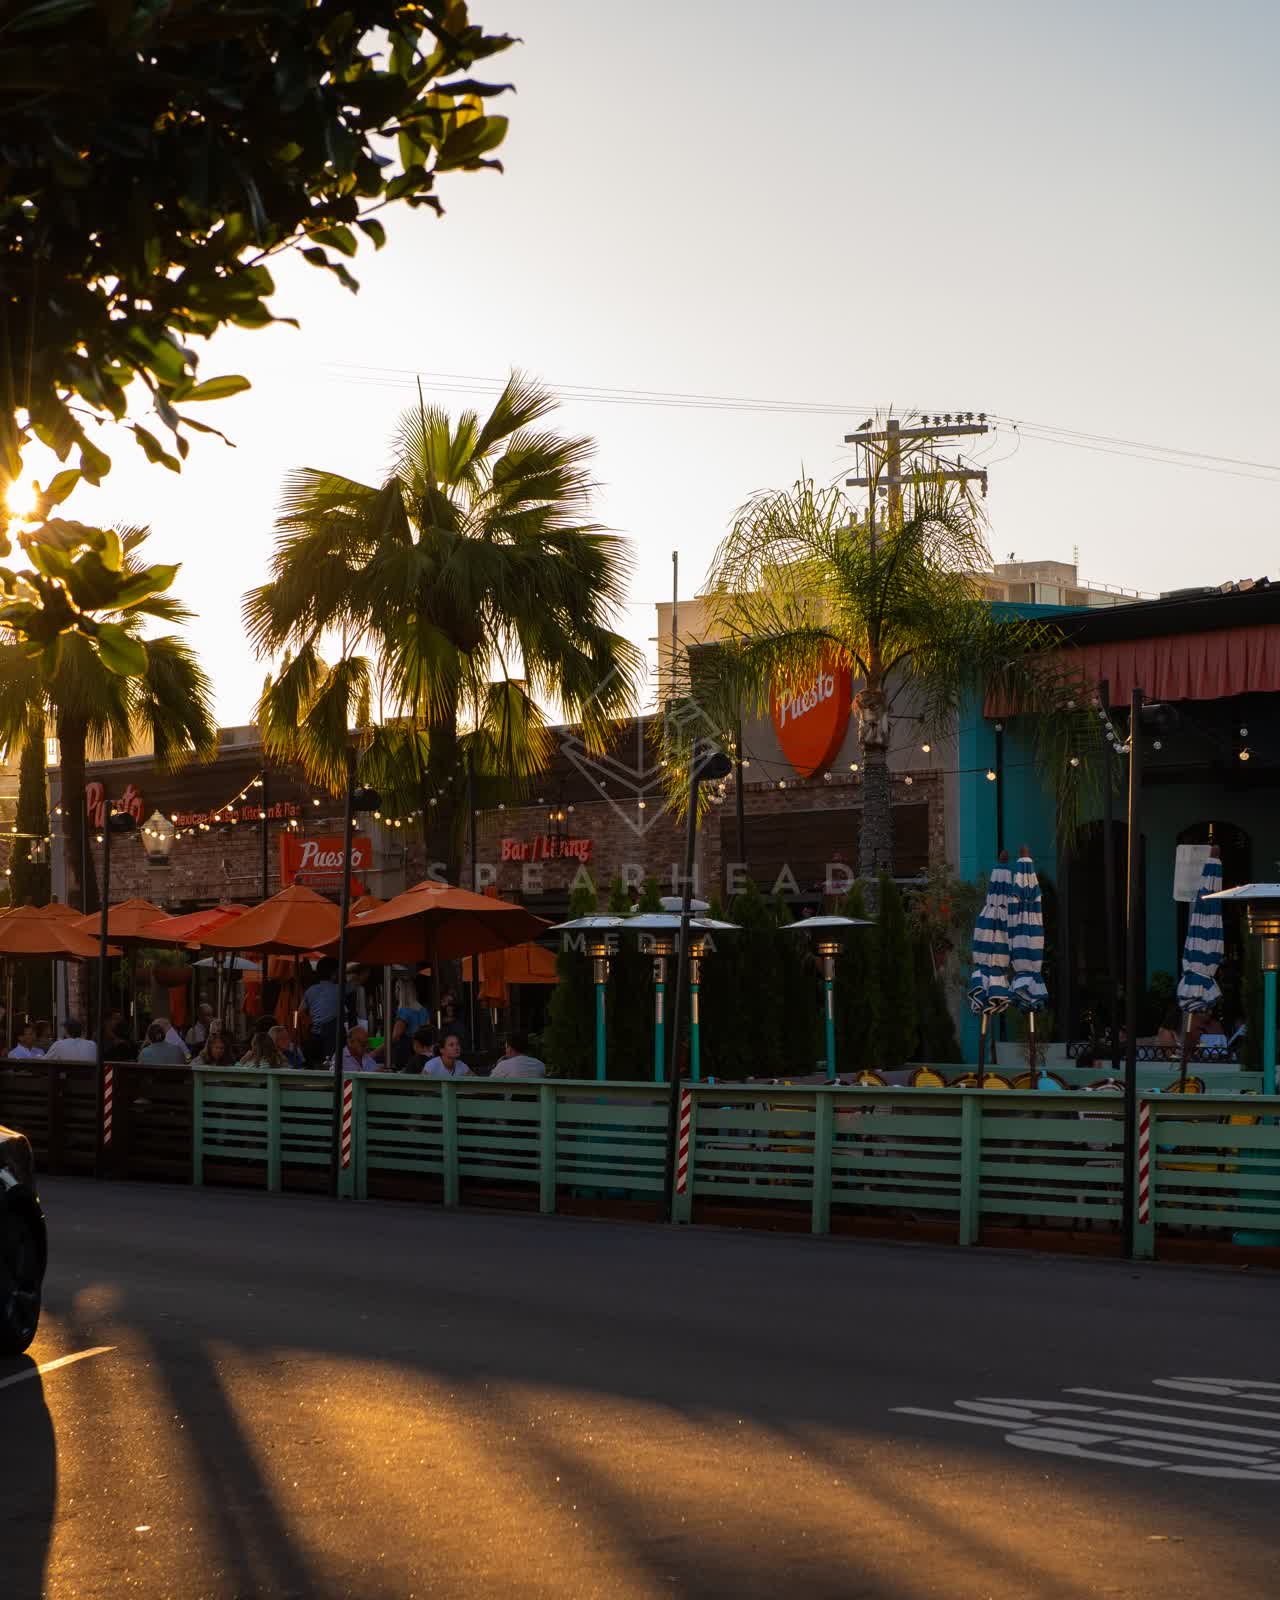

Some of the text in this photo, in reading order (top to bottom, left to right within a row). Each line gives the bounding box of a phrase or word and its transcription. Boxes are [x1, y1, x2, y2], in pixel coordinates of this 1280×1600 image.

[778, 672, 834, 728] Puesto
[86, 782, 142, 827] Pusto
[299, 841, 363, 868] Pueso
[501, 838, 529, 861] Bar
